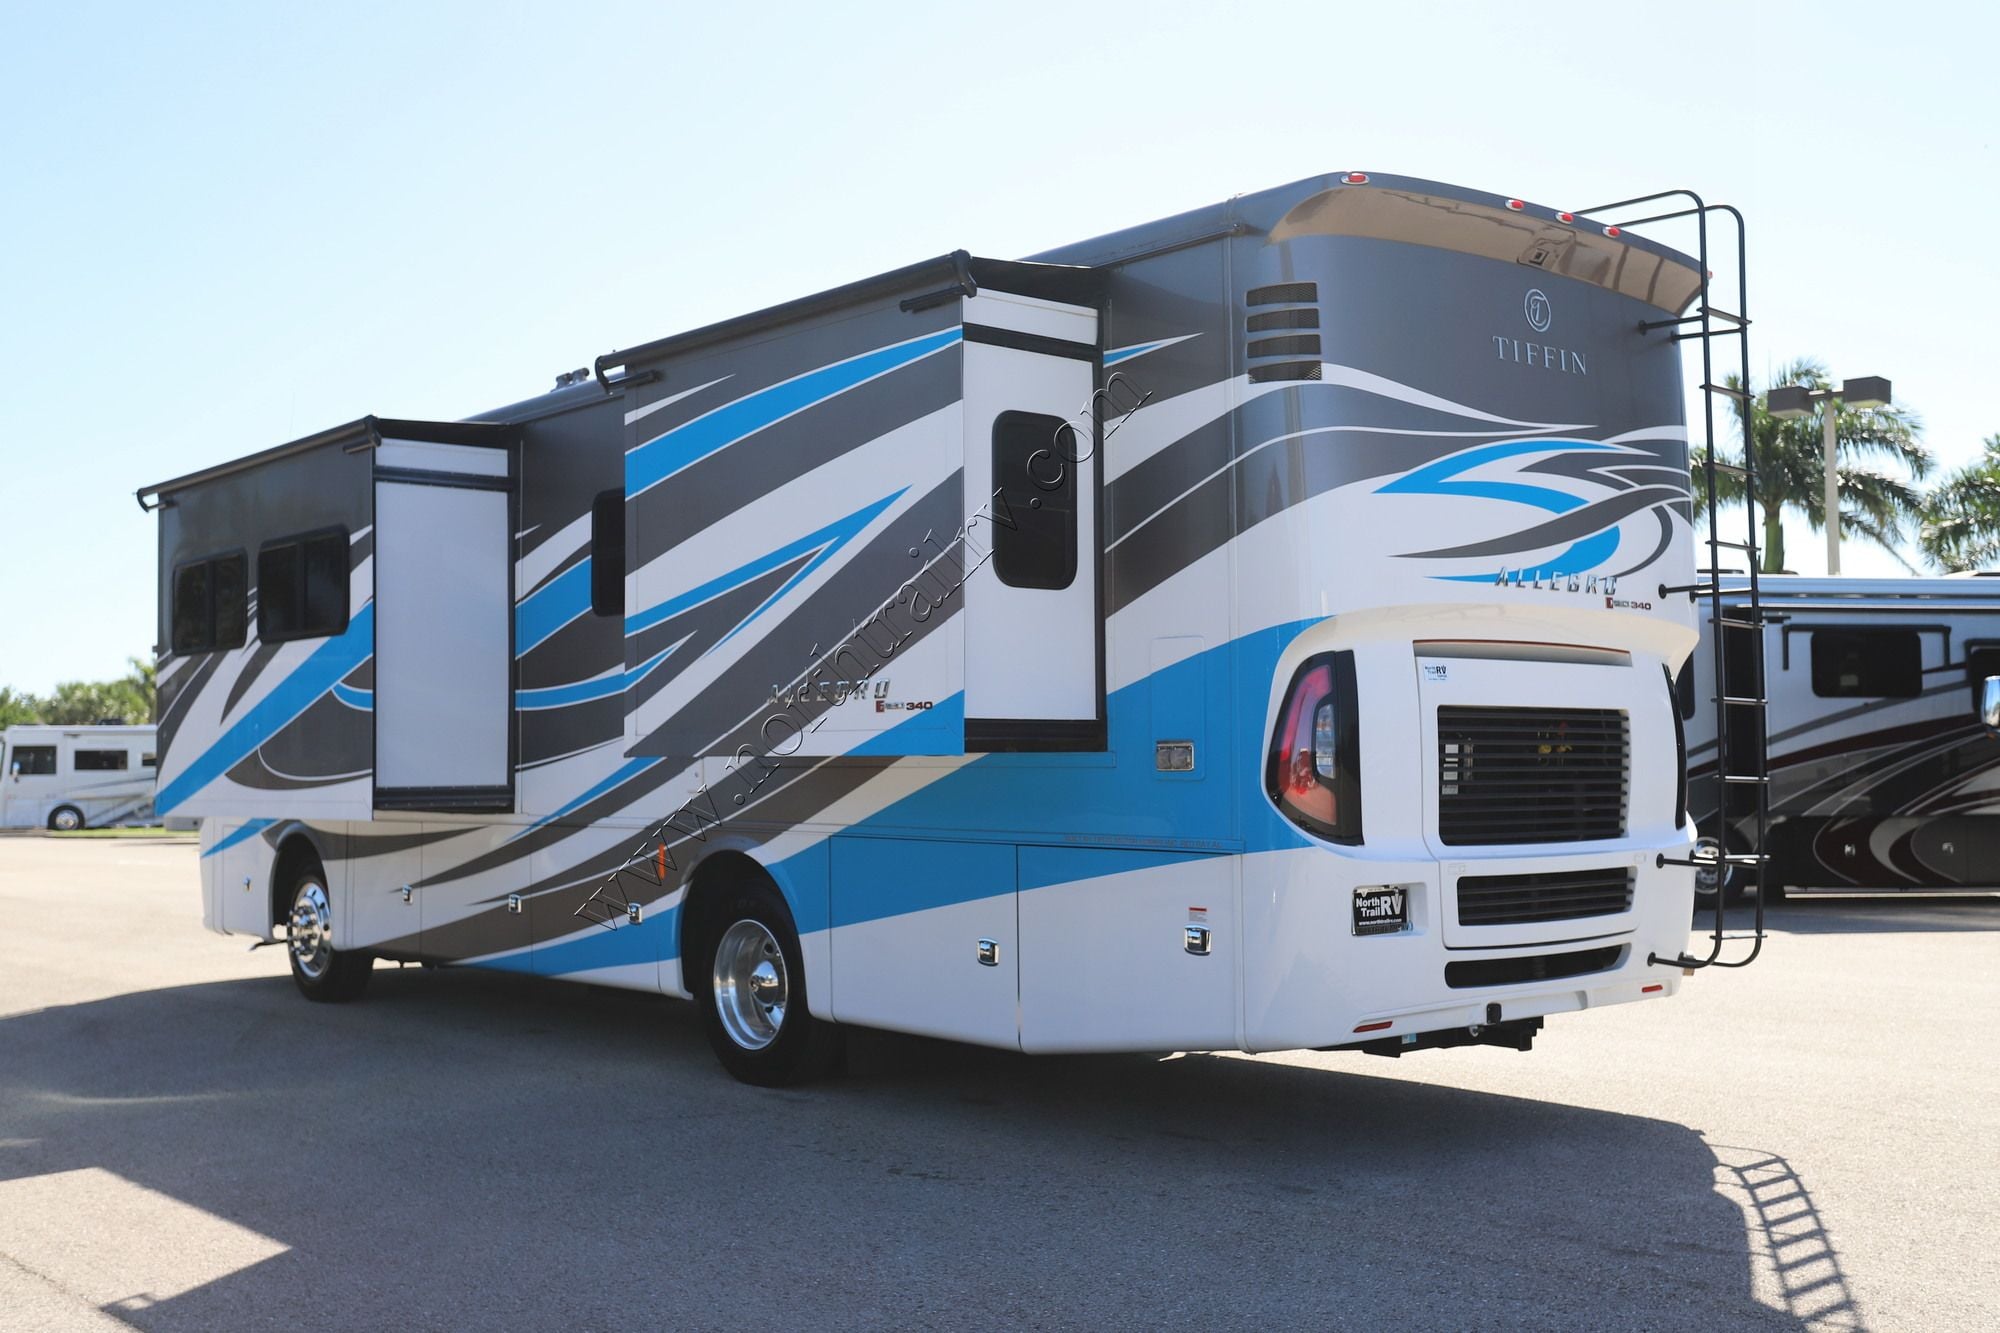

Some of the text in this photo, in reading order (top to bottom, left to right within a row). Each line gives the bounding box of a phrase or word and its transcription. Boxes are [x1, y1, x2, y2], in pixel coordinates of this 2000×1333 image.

[1492, 335, 1588, 376] TIFFIN
[1494, 566, 1618, 596] ALLEGRO
[1630, 601, 1652, 611] 340
[767, 678, 891, 704] ALLEGRO
[906, 701, 933, 711] 340
[1356, 897, 1380, 908] North
[1380, 894, 1403, 915] RV
[1361, 908, 1380, 917] Trail
